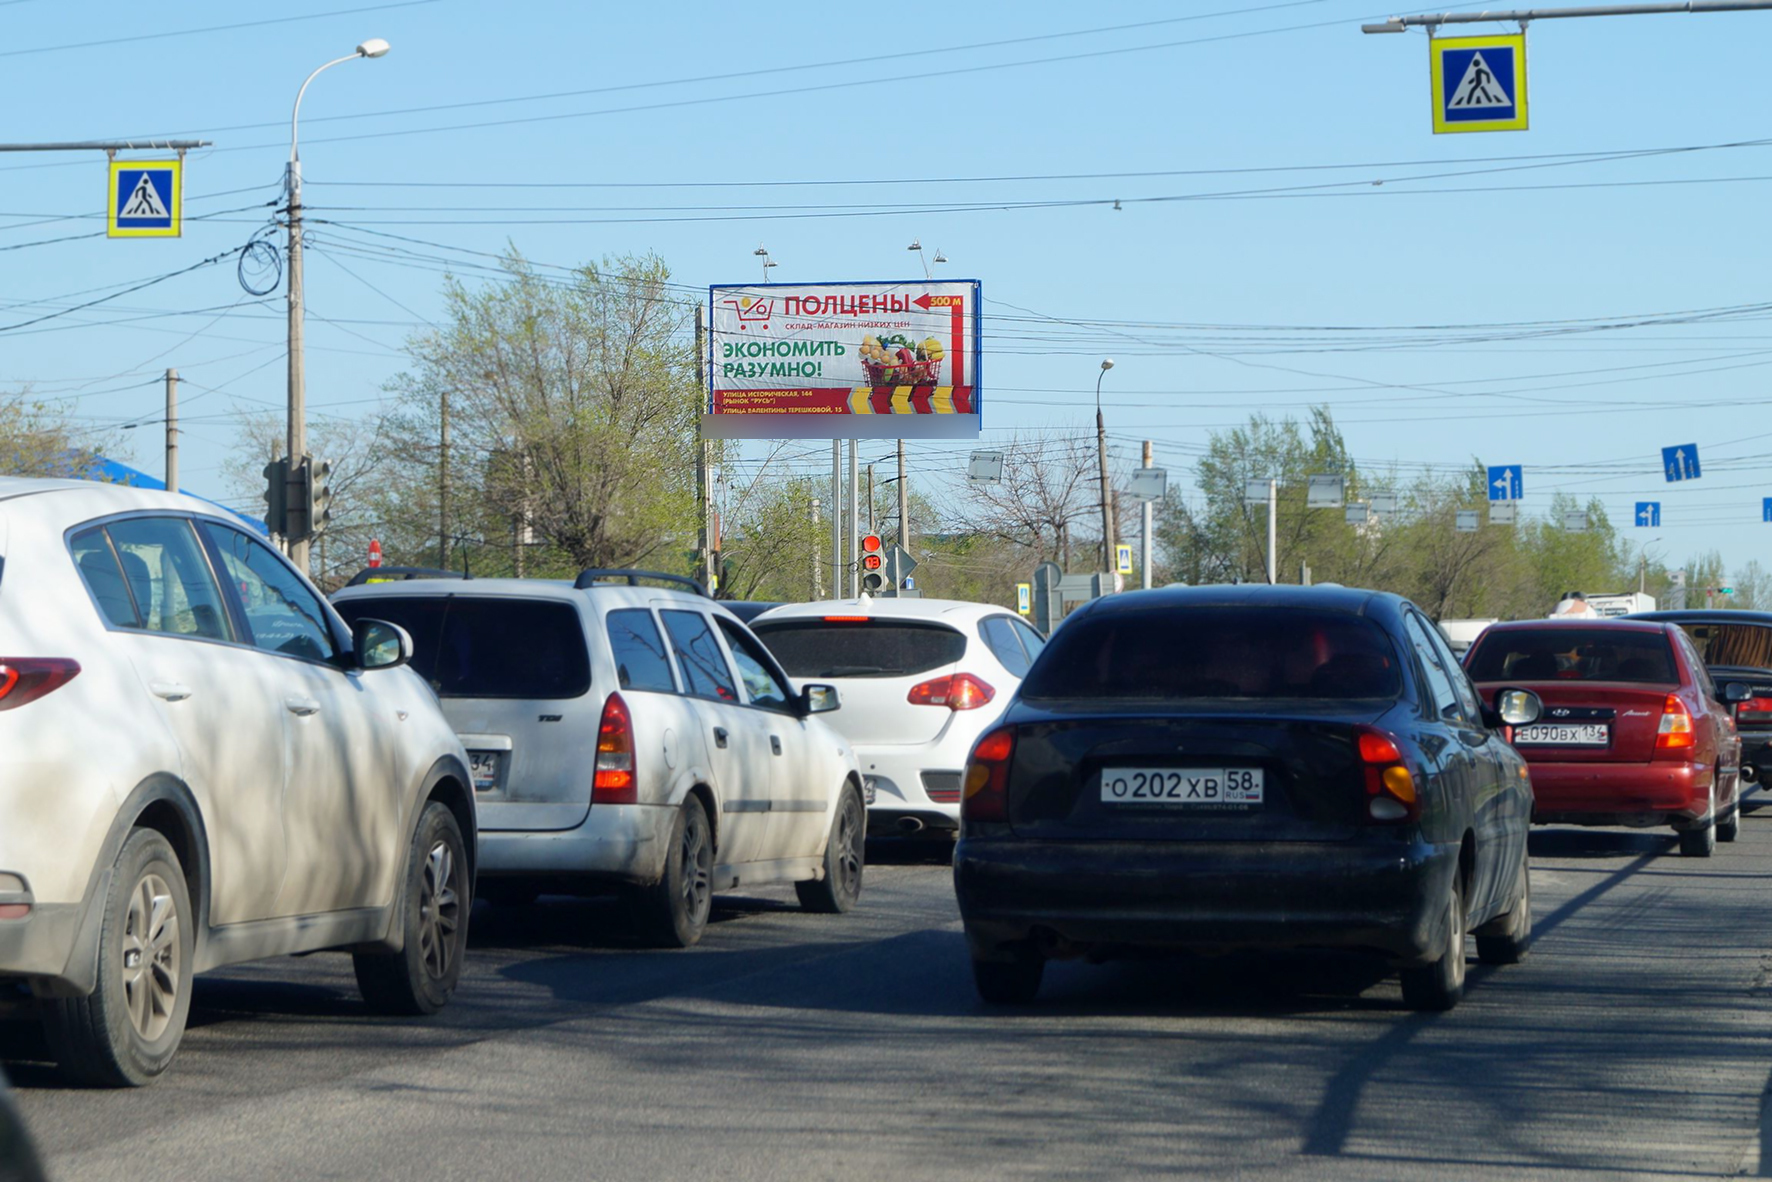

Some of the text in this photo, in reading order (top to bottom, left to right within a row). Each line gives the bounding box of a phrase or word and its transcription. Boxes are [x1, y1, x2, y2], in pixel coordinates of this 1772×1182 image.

[785, 294, 909, 317] ПОЛЦЕНЫ
[930, 297, 951, 306] 500
[785, 321, 910, 330] СКЛАД-МАГАЗИН НИЗКИХ ЦЕН
[723, 341, 846, 358] ЭКОНОМИТЬ
[723, 361, 822, 378] РАЗУМНО!
[723, 407, 746, 415] УЛИЦА
[788, 405, 832, 414] ТЕРЕШКОВОЙ,
[1227, 771, 1253, 790] 58
[1226, 791, 1245, 799] RUS
